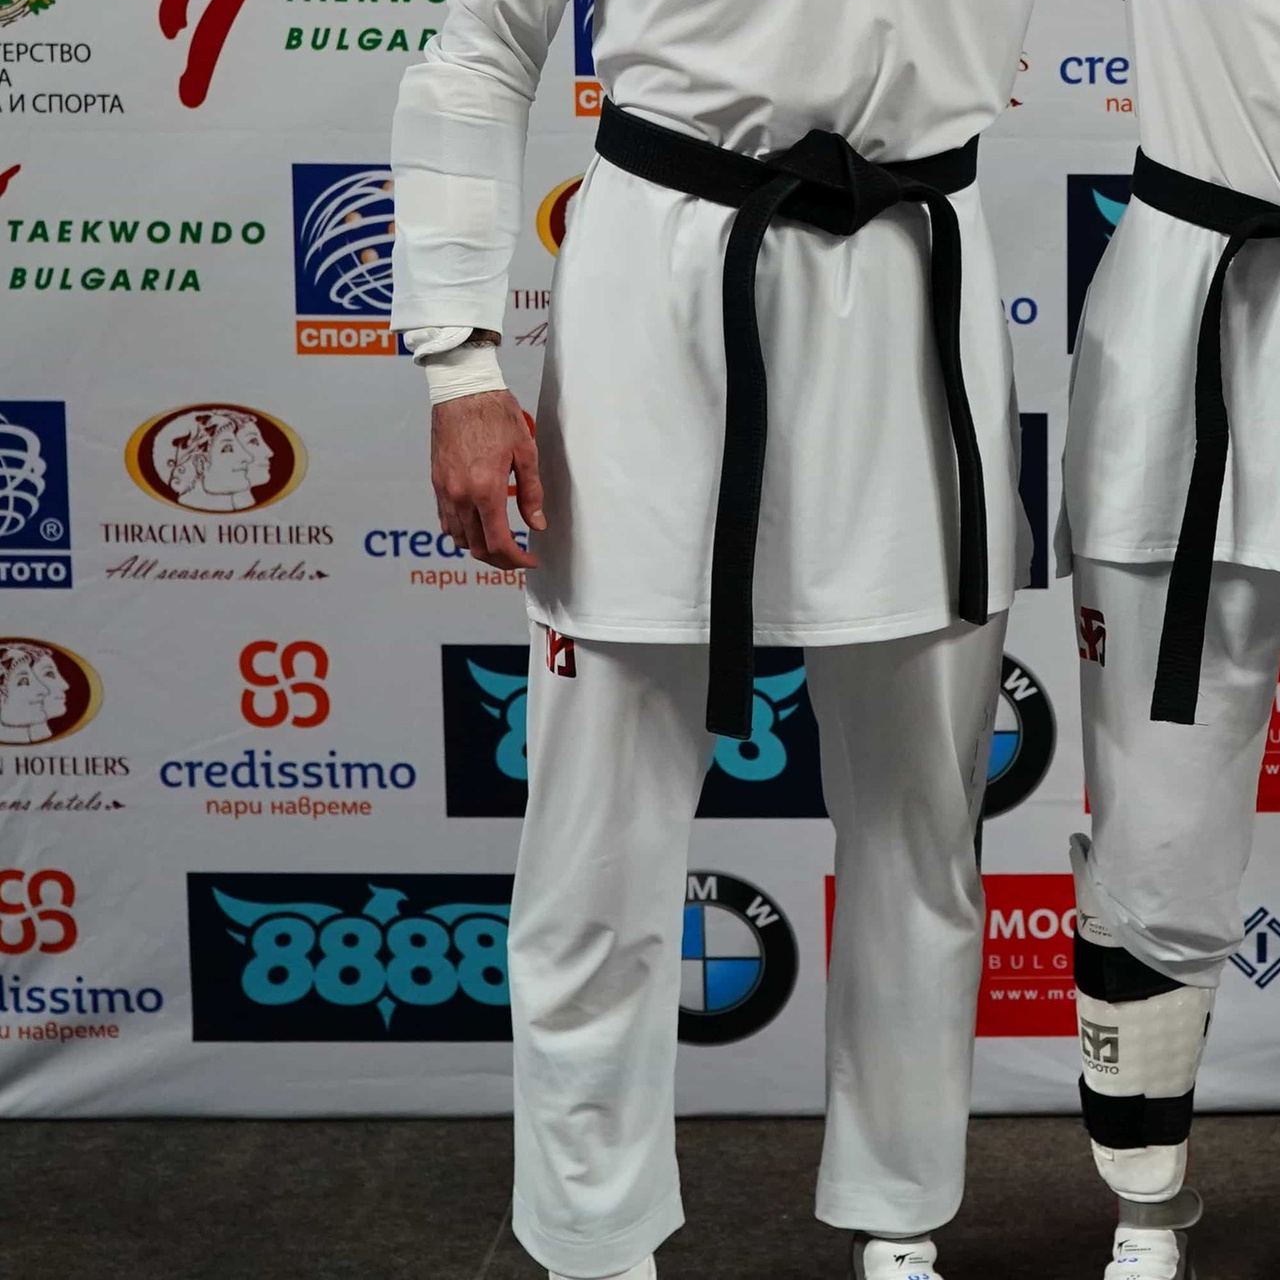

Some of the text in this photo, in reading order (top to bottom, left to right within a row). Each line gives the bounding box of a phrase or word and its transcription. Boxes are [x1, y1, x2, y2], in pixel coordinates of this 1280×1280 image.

[285, 26, 434, 53] BULGA
[0, 42, 92, 64] ЕРСТВО
[0, 69, 12, 87] А
[10, 94, 24, 112] И
[33, 94, 124, 113] СПОРТА
[1107, 98, 1132, 112] па
[8, 220, 265, 244] TAEKWONDO
[9, 268, 200, 291] BULGARIA
[301, 328, 393, 349] СПОРТ
[101, 524, 333, 544] THRACIAN HOTELIERS
[106, 555, 305, 580] All seasons hotels
[411, 569, 527, 590] пари навр
[16, 757, 129, 775] HOTELIERS
[160, 750, 416, 789] credissimo
[39, 791, 101, 811] hotels
[206, 796, 372, 819] пари навреме
[687, 877, 780, 928] MW
[989, 908, 1076, 940] MOO
[242, 917, 511, 1007] 8888
[989, 954, 1067, 969] BULG
[0, 974, 163, 1014] issimo
[990, 987, 1076, 1001] www.mo
[16, 1022, 119, 1044] навреме
